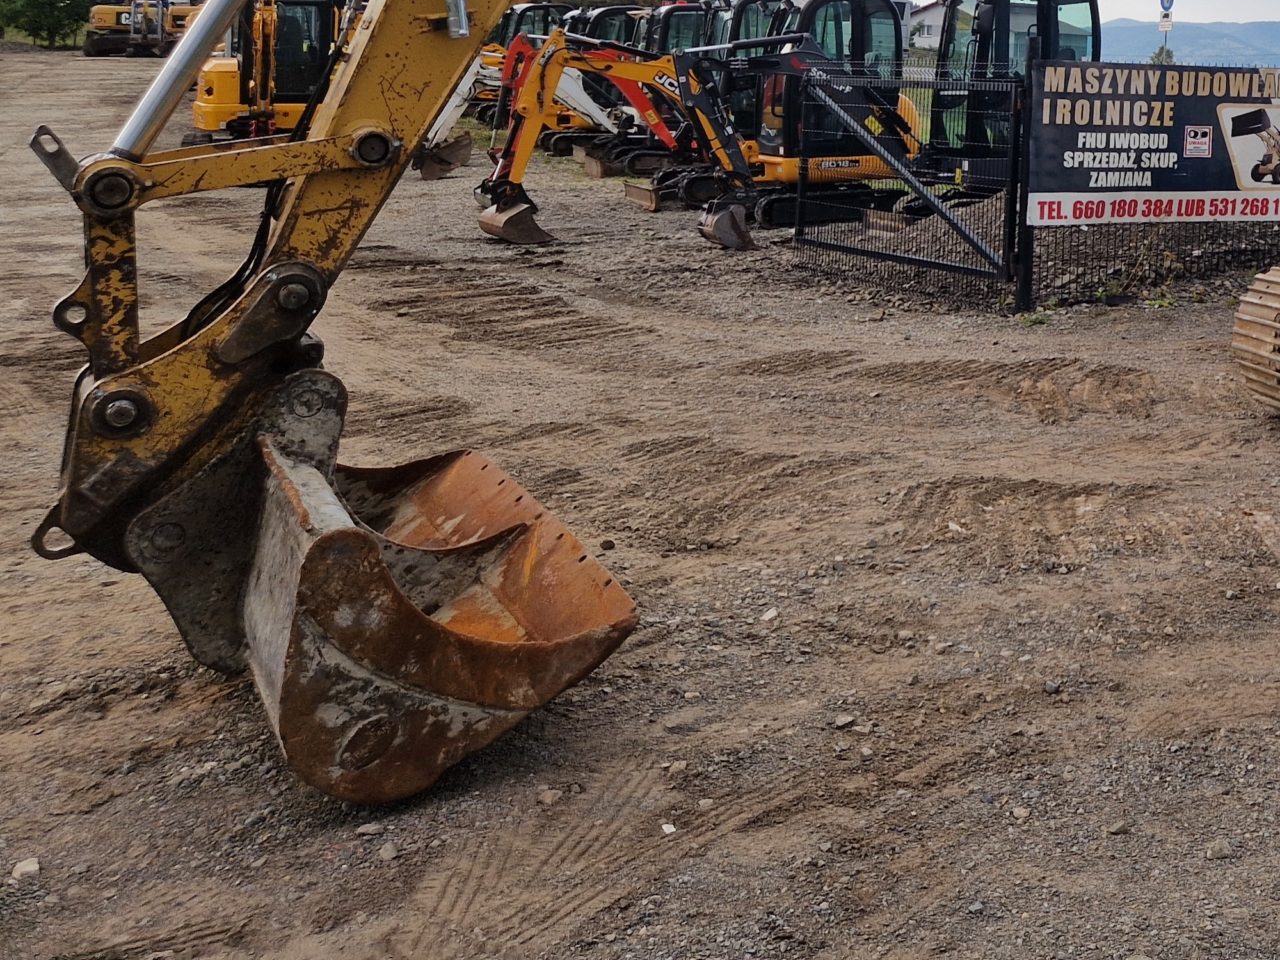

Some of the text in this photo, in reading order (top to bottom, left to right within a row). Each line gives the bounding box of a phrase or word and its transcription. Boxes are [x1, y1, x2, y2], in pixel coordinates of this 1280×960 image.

[1043, 66, 1161, 96] MASZYNY
[1042, 98, 1175, 127] I ROLNICZE
[1077, 132, 1169, 149] FHU IWOBUD
[1063, 150, 1178, 169] SPRZEDAŻ, SKUP,
[1089, 171, 1152, 188] ZAMIANA
[1037, 200, 1068, 220] TEL.
[1072, 200, 1106, 220] 660
[1109, 199, 1138, 218] 180
[1141, 198, 1174, 218] 384
[1176, 198, 1206, 217] LUB
[1208, 198, 1237, 217] 531
[1239, 197, 1270, 216] 268
